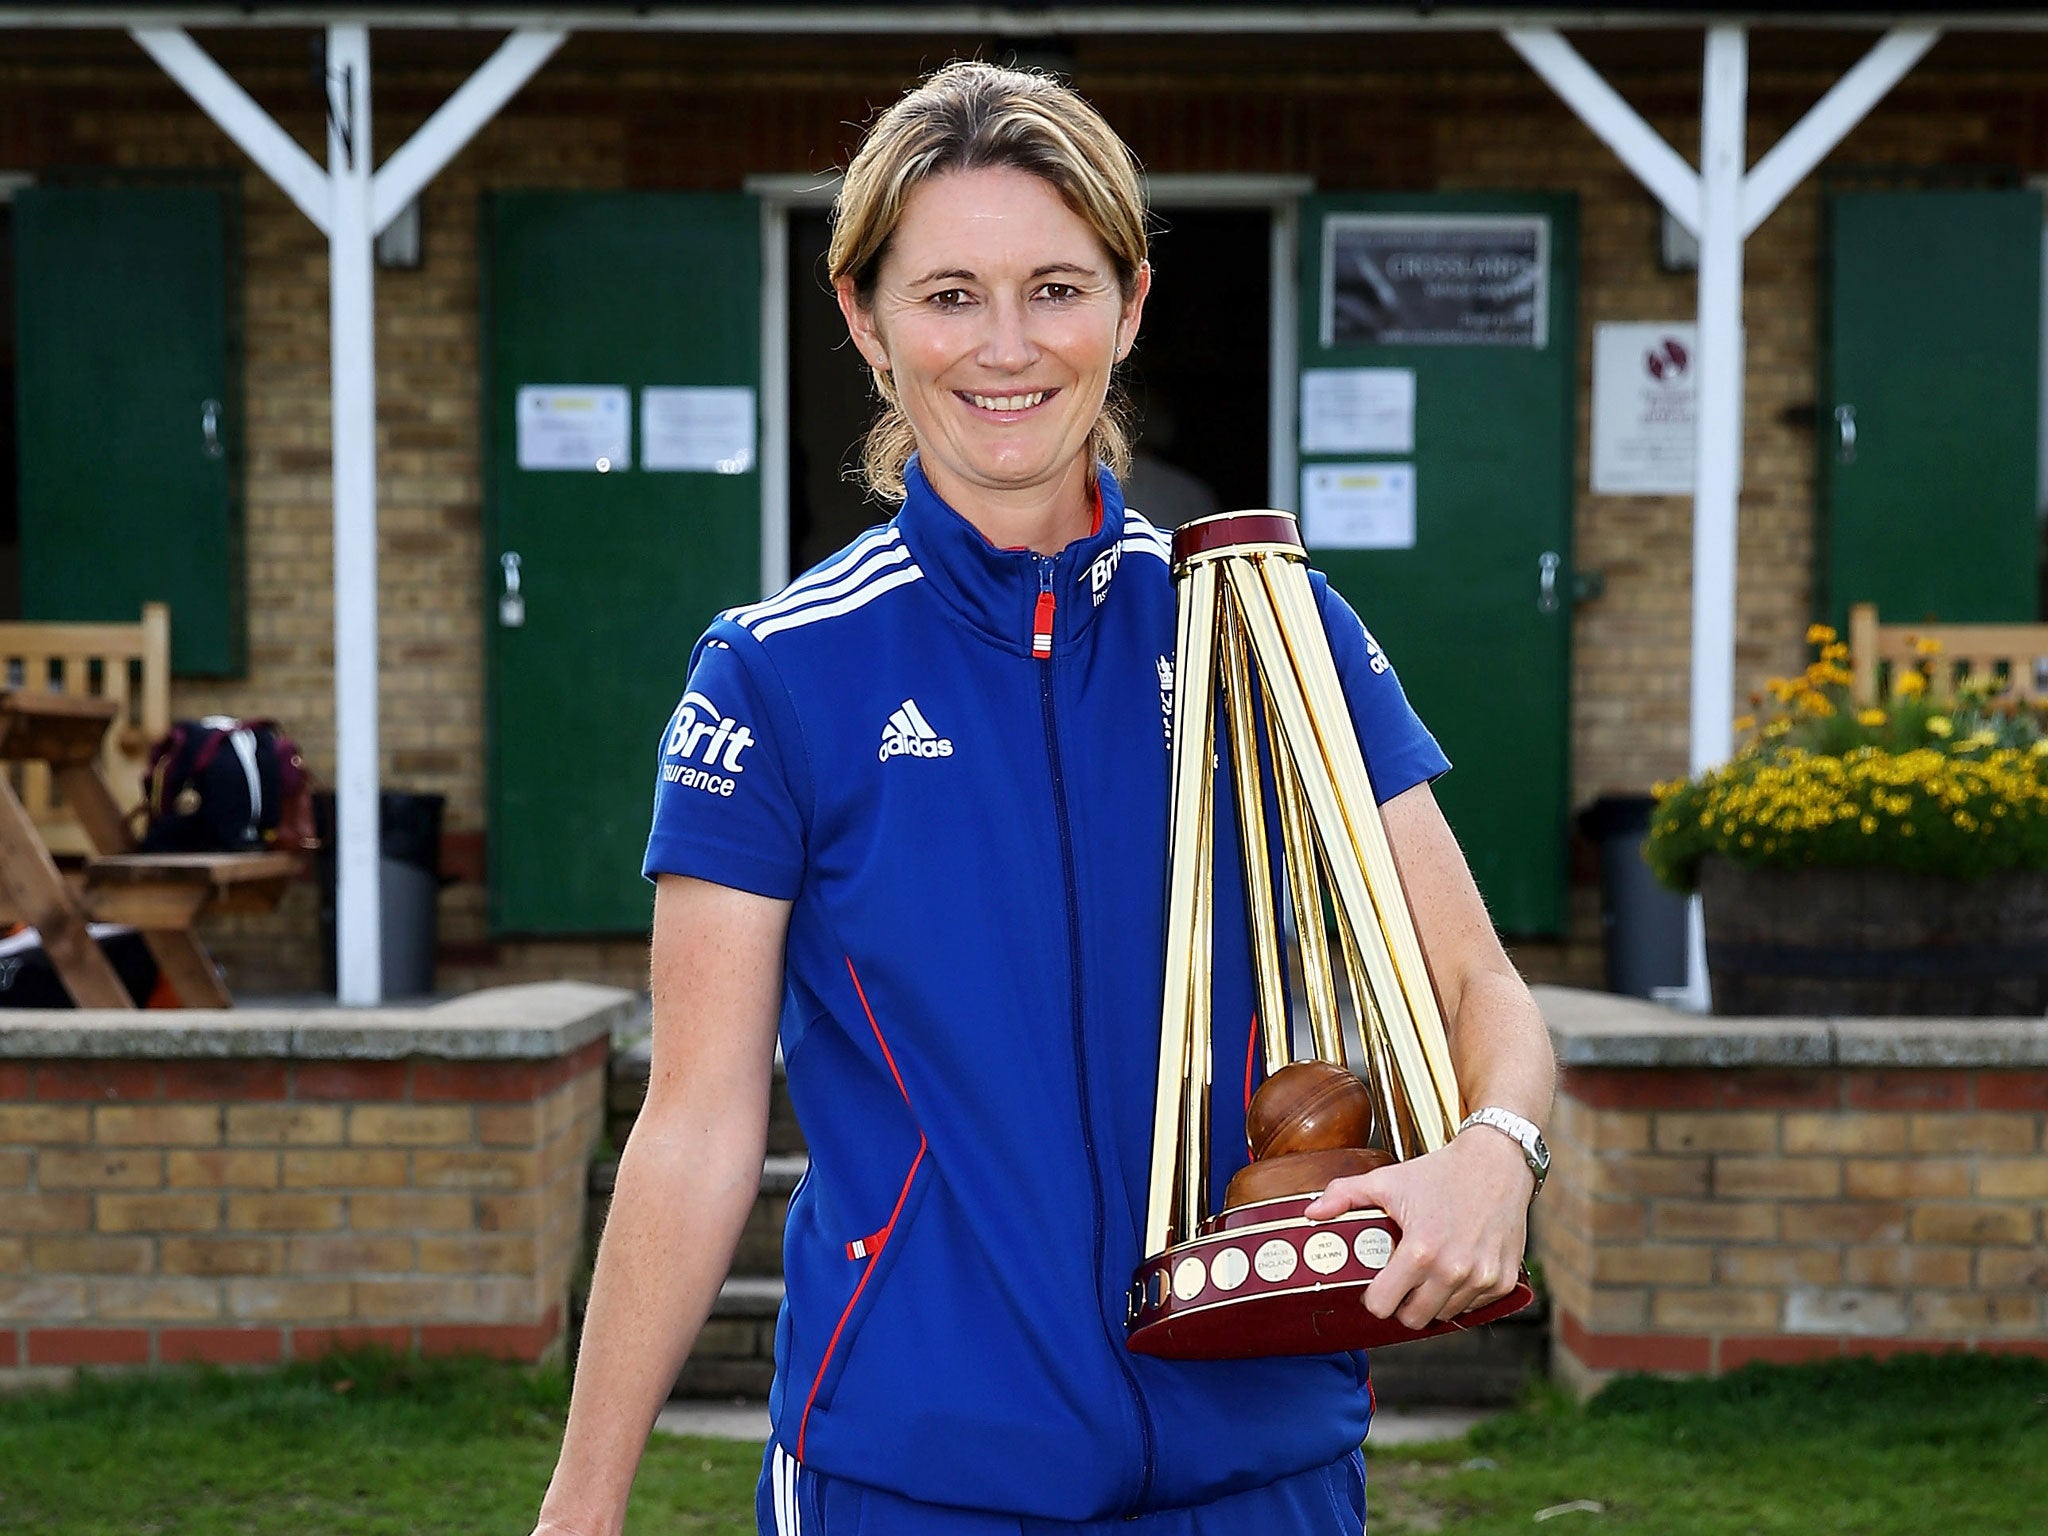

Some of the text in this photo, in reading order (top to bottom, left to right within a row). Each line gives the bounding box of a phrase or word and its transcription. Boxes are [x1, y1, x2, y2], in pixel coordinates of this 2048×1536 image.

[1091, 539, 1121, 593] Brit
[666, 706, 755, 773] Brit
[879, 732, 954, 763] adidas
[663, 763, 735, 797] surance
[1257, 1257, 1295, 1271] ENGLAND
[1310, 1249, 1344, 1262] DRAWN
